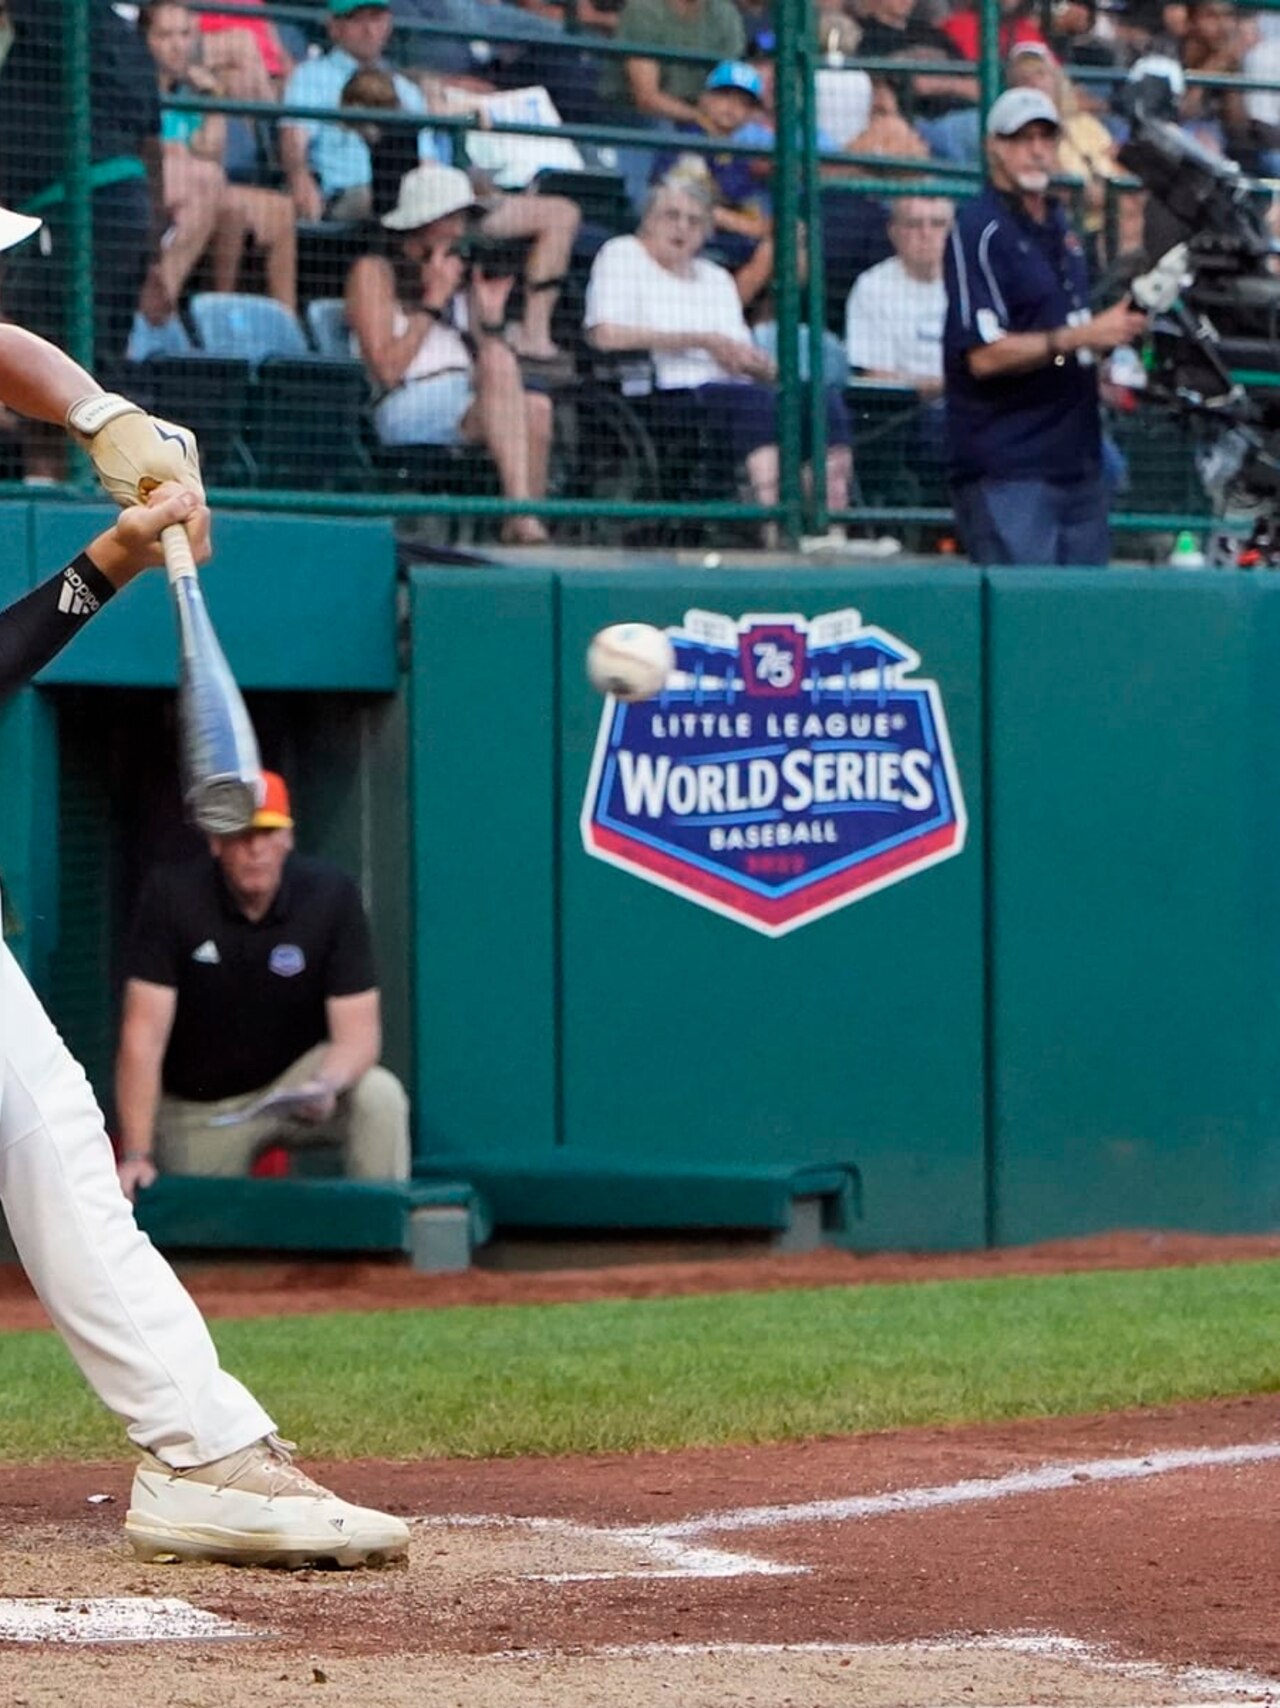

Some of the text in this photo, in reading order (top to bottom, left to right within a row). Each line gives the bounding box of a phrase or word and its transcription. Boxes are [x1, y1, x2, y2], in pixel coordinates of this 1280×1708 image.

[64, 567, 99, 611] adidas
[753, 642, 795, 687] 75
[652, 713, 752, 738] LITTLE
[618, 749, 933, 818] WORLD SERIES
[709, 818, 838, 851] BASEBALL
